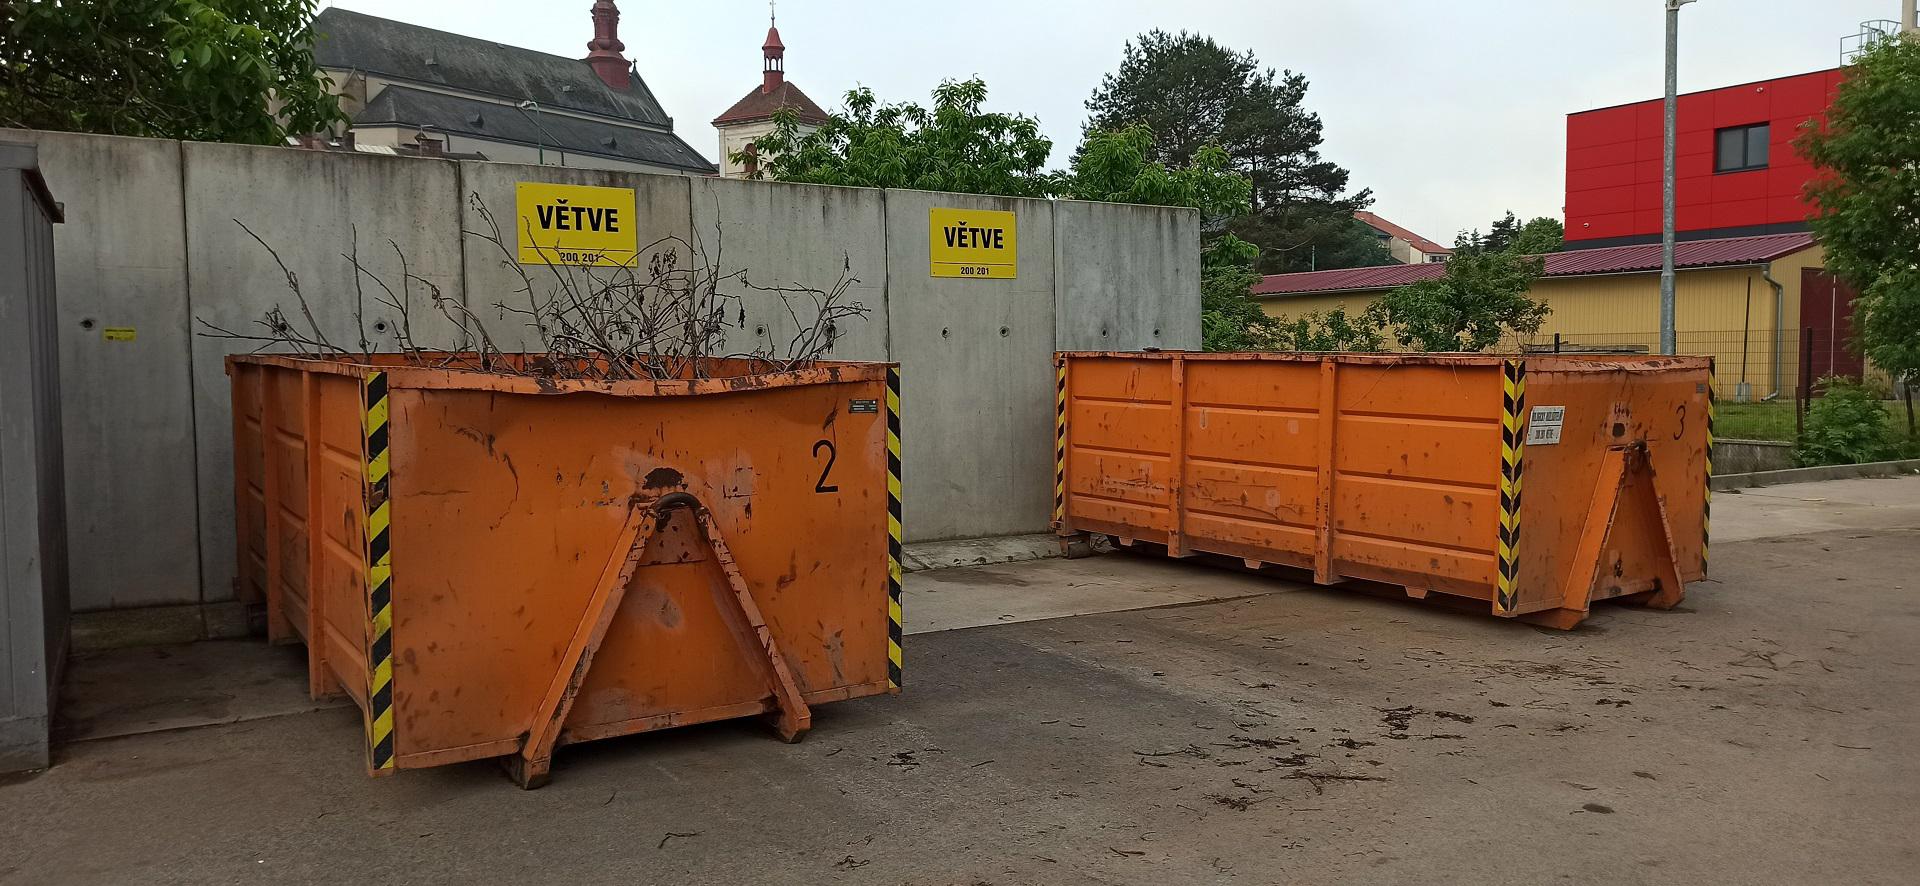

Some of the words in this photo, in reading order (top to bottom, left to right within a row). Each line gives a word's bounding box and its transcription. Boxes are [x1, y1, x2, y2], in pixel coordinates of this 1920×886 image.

[536, 198, 619, 233] VĚTVE
[943, 221, 1004, 249] VĚTVE
[560, 252, 578, 261] 200
[582, 253, 599, 262] 201
[960, 266, 974, 275] 200
[976, 267, 989, 275] 201
[1673, 405, 1686, 440] 3
[812, 439, 839, 493] 2
